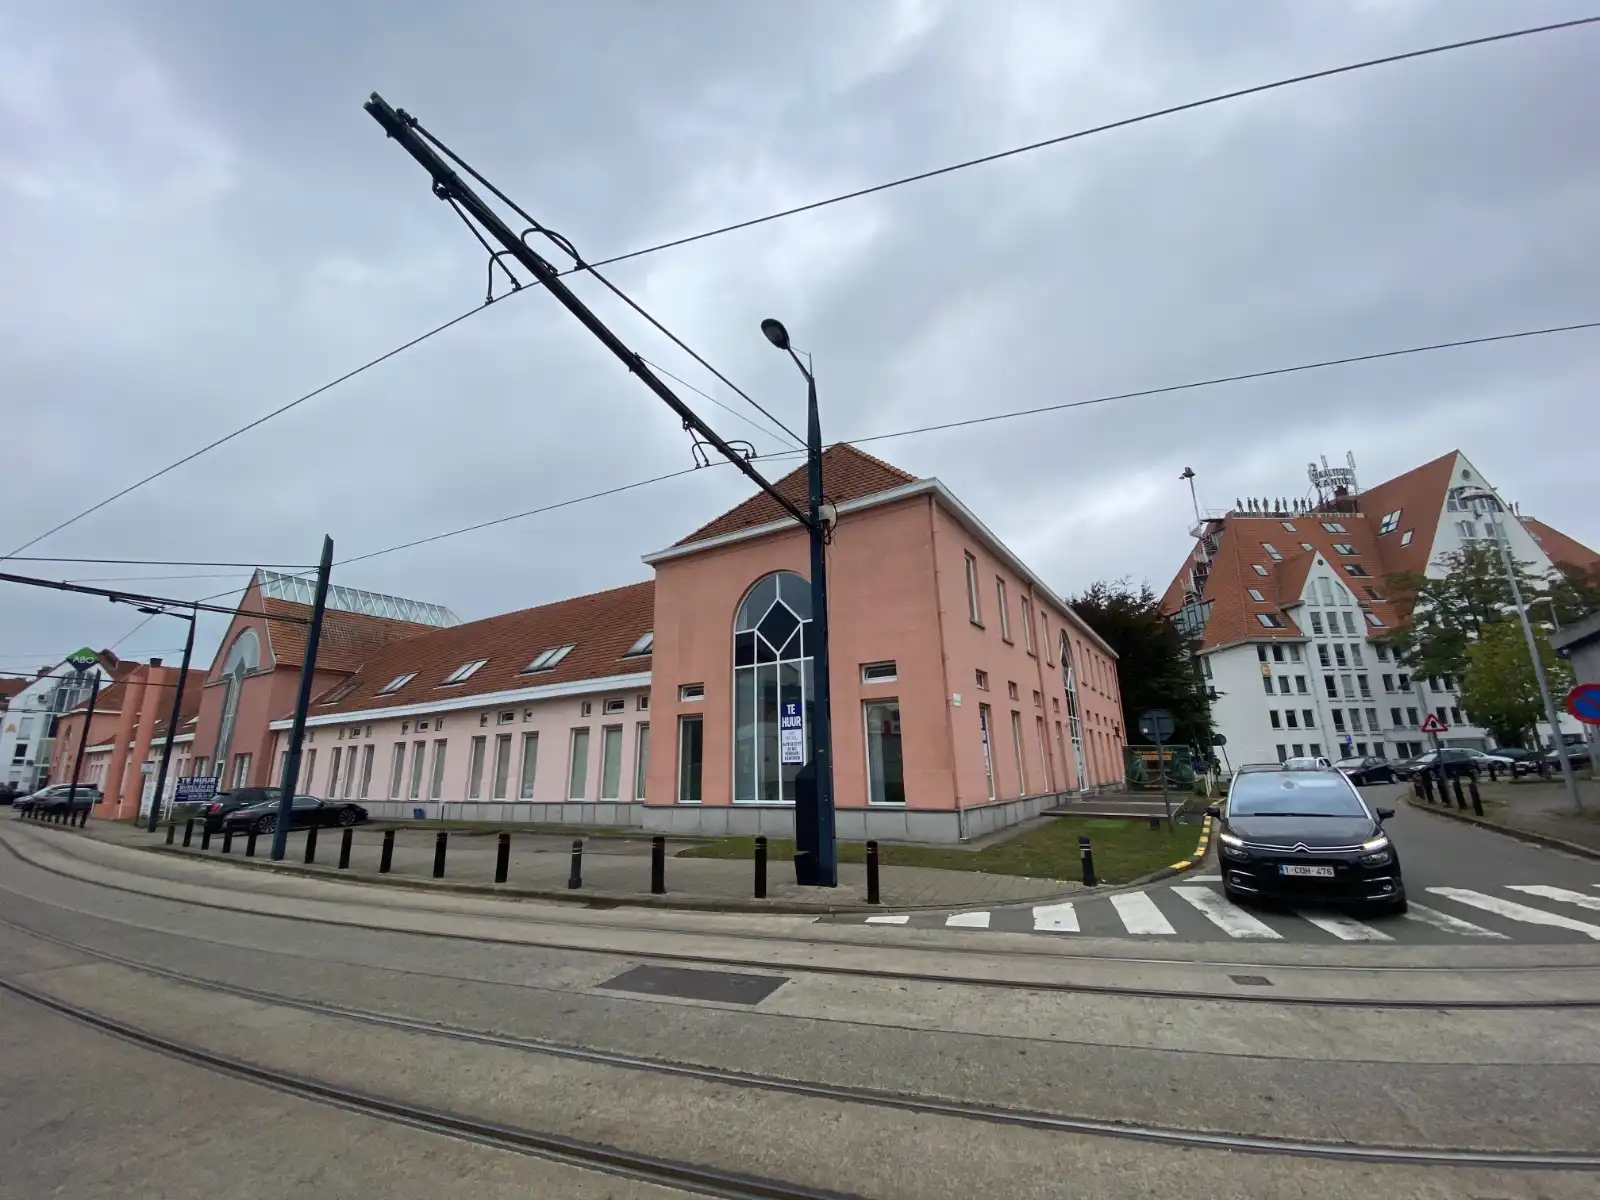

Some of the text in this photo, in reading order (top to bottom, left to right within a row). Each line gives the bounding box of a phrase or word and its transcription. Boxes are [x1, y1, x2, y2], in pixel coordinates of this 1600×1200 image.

[73, 656, 94, 664] ABO
[786, 704, 796, 715] TE
[782, 716, 802, 728] HUUR
